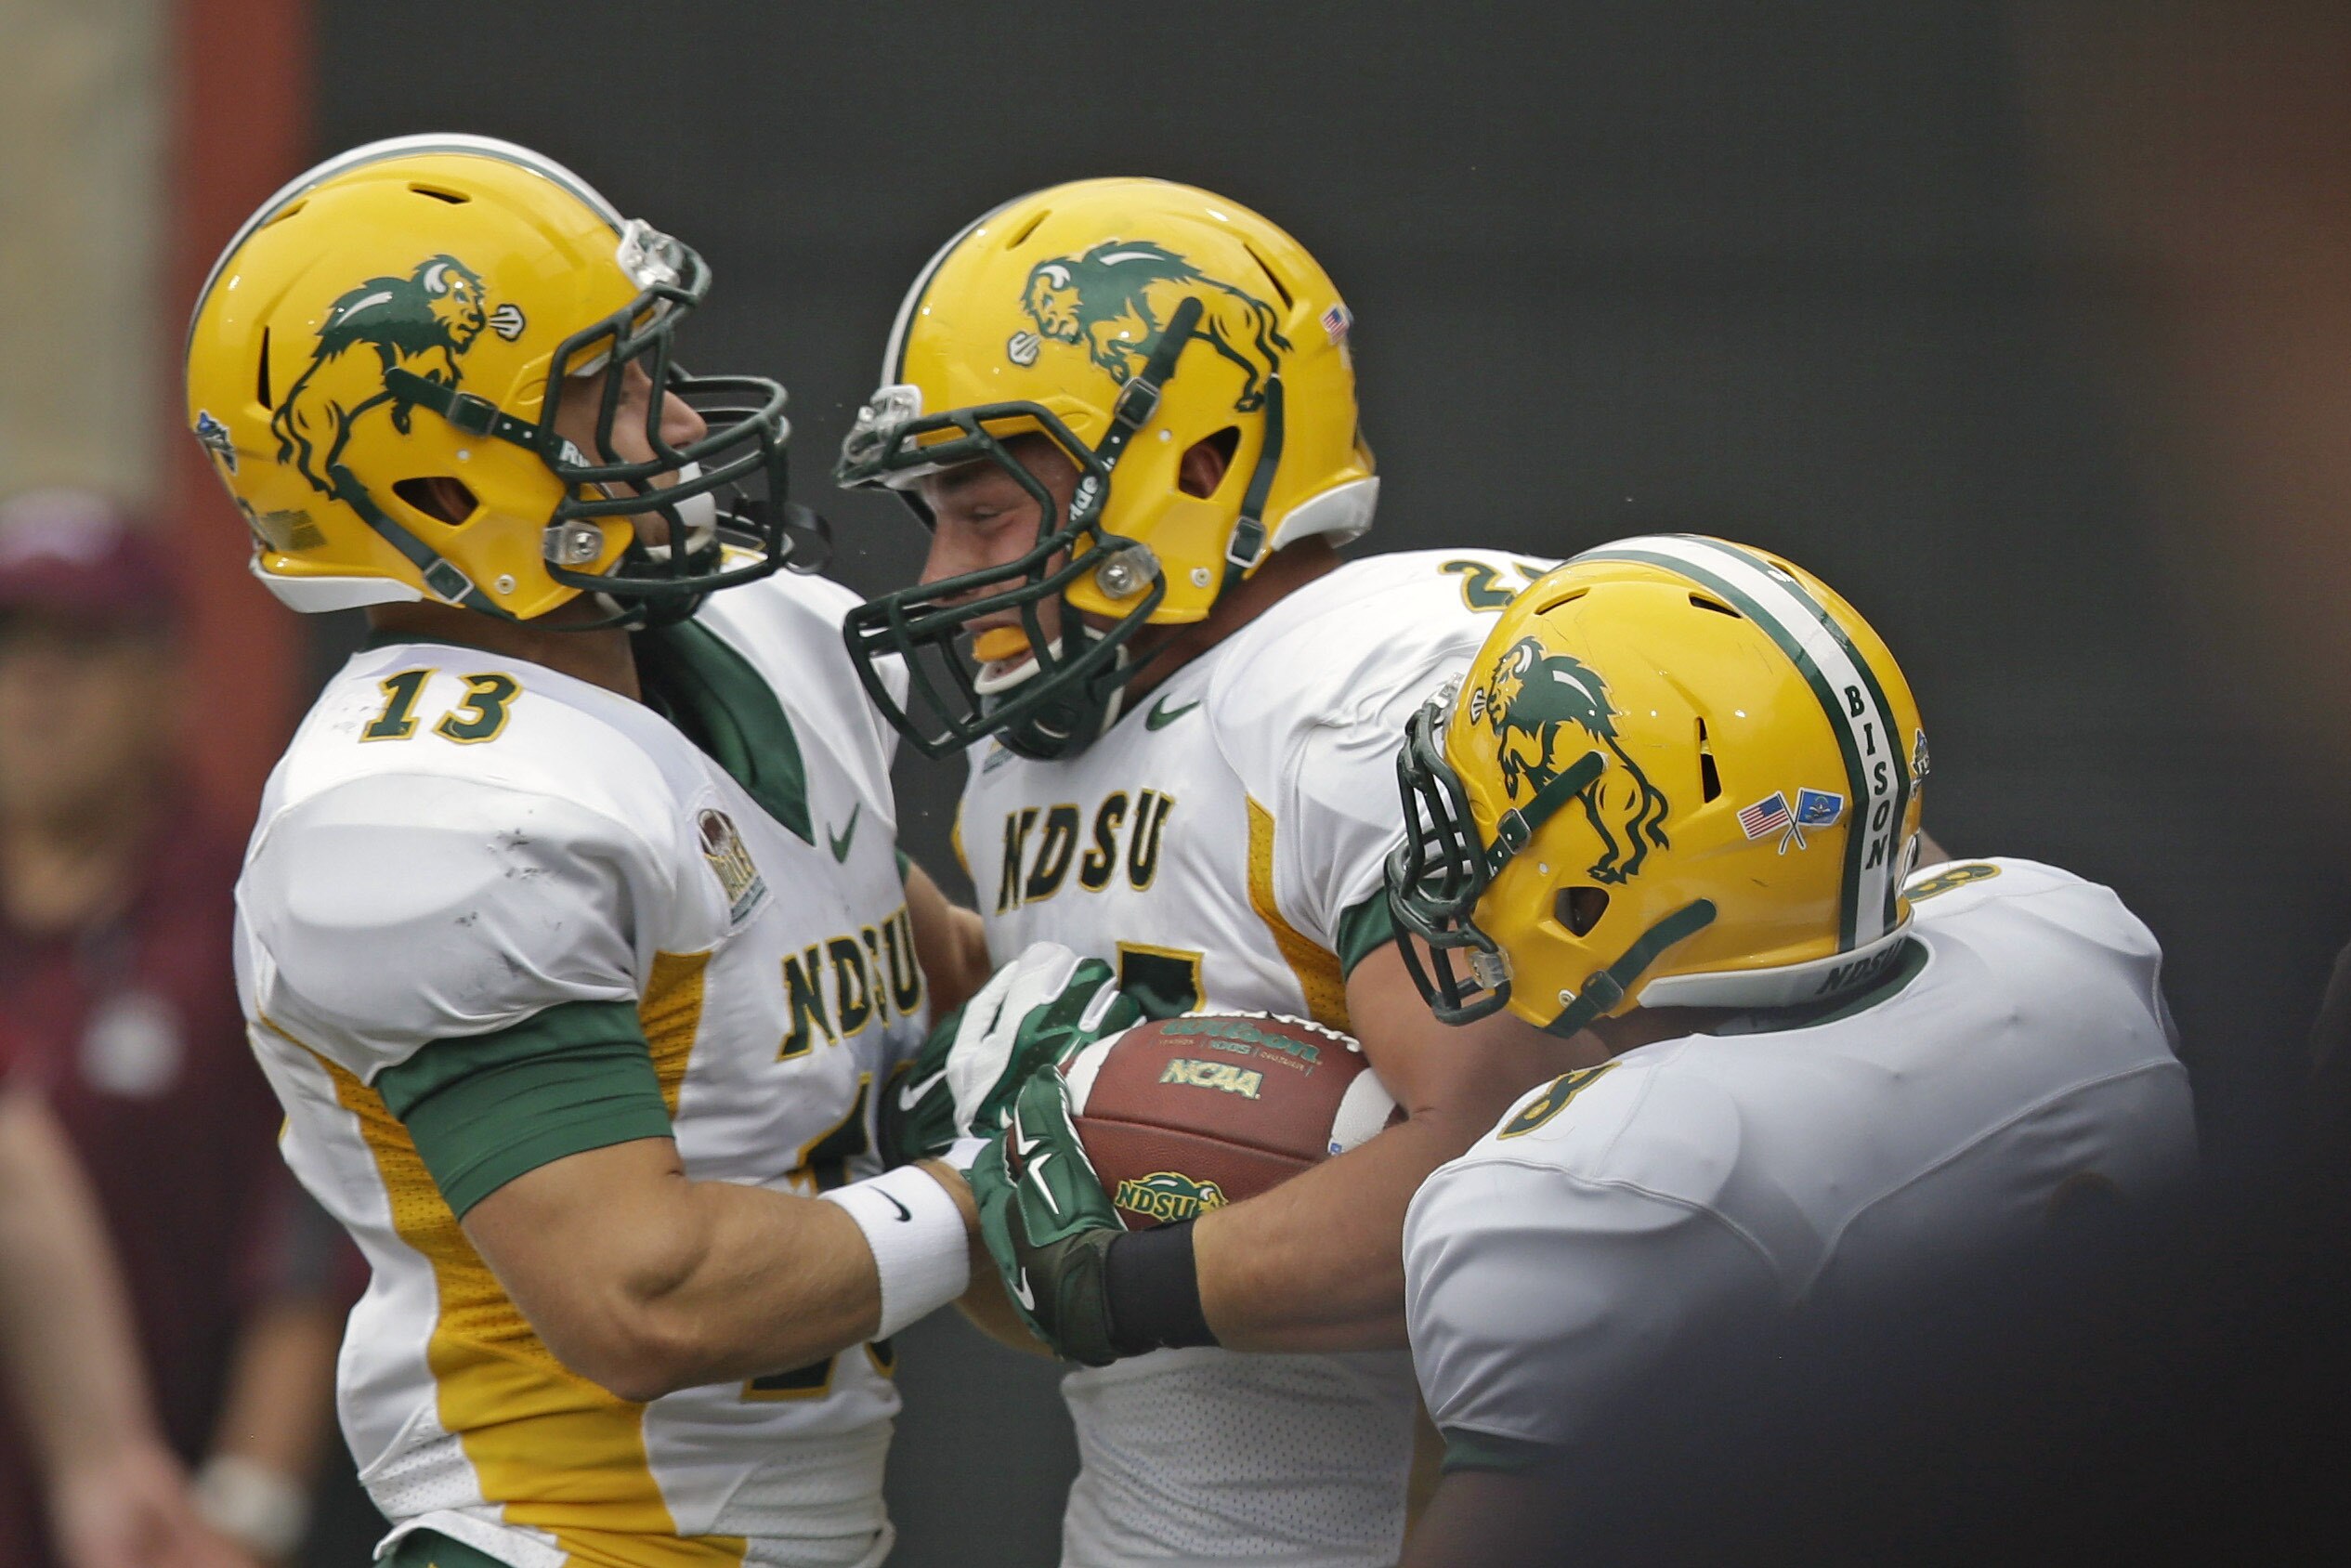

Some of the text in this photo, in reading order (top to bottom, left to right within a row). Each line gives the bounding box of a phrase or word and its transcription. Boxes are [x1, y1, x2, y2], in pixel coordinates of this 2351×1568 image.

[1438, 559, 1549, 613] 2
[359, 668, 523, 745] 13
[1844, 685, 1891, 870] BISON
[995, 788, 1176, 916] NDSU
[1158, 1057, 1264, 1101] NCAA
[1495, 1060, 1624, 1142] 8
[1115, 1180, 1198, 1222] NDSU
